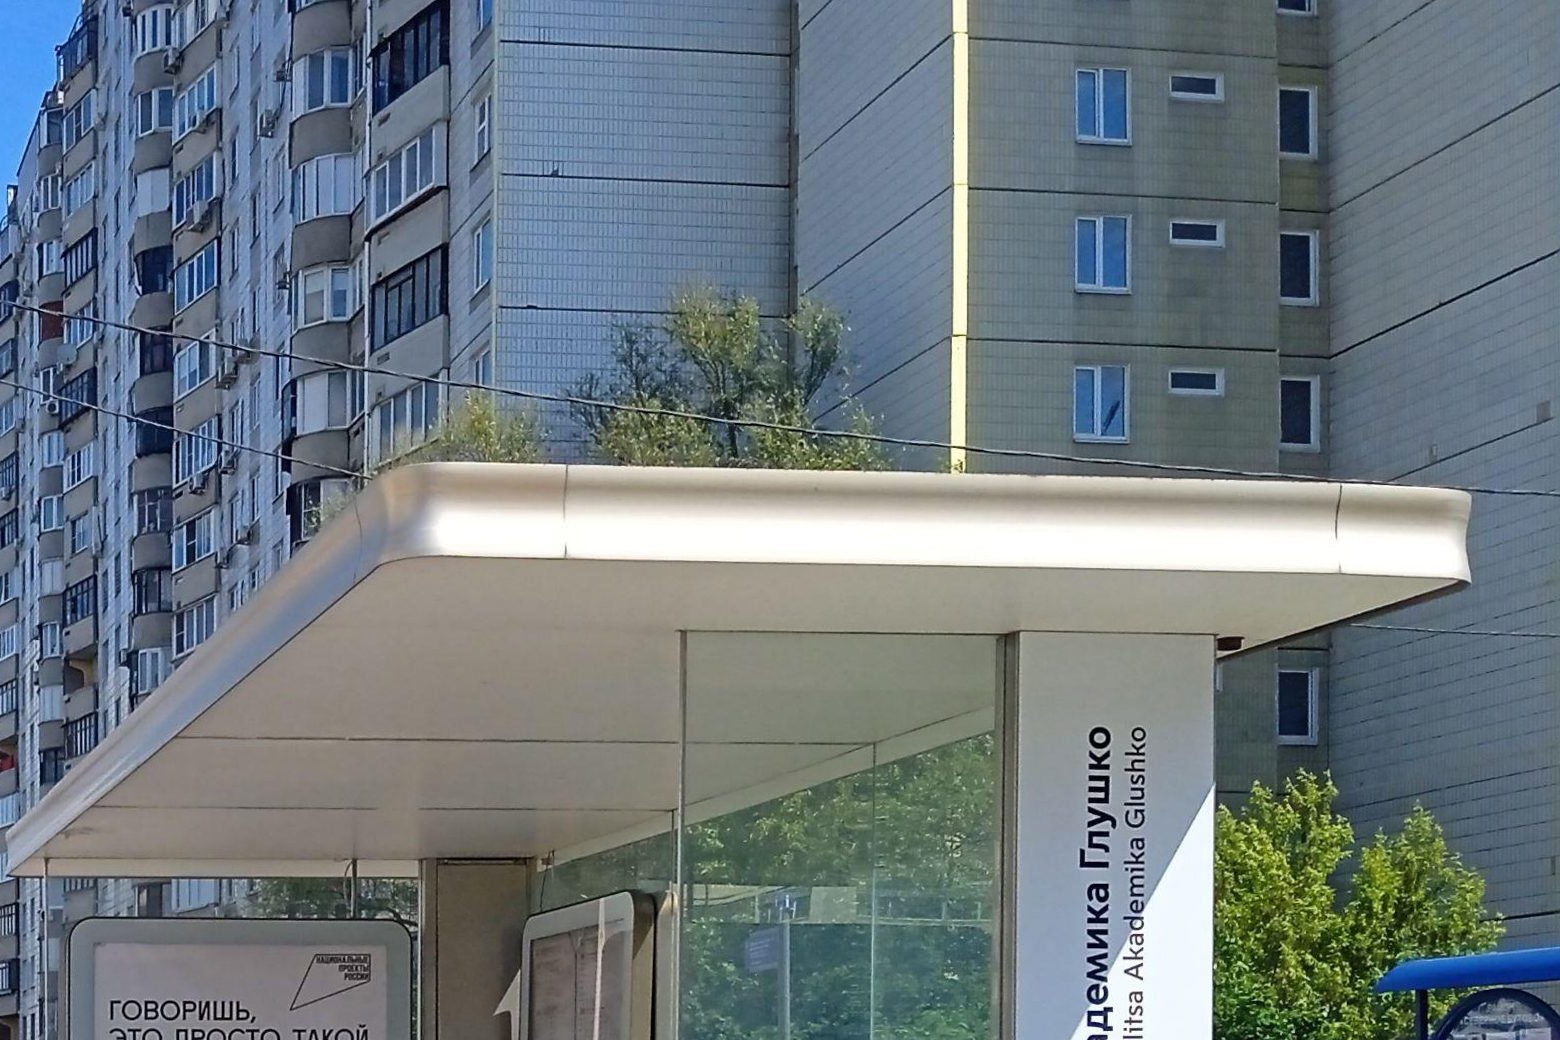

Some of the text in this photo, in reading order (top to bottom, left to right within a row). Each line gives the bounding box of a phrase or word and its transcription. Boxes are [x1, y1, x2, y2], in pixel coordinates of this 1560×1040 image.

[1079, 726, 1117, 869] Глушко
[1124, 726, 1148, 829] Glushko
[1122, 837, 1147, 980] Akademika
[108, 1000, 257, 1024] ГОВОРИШЬ,
